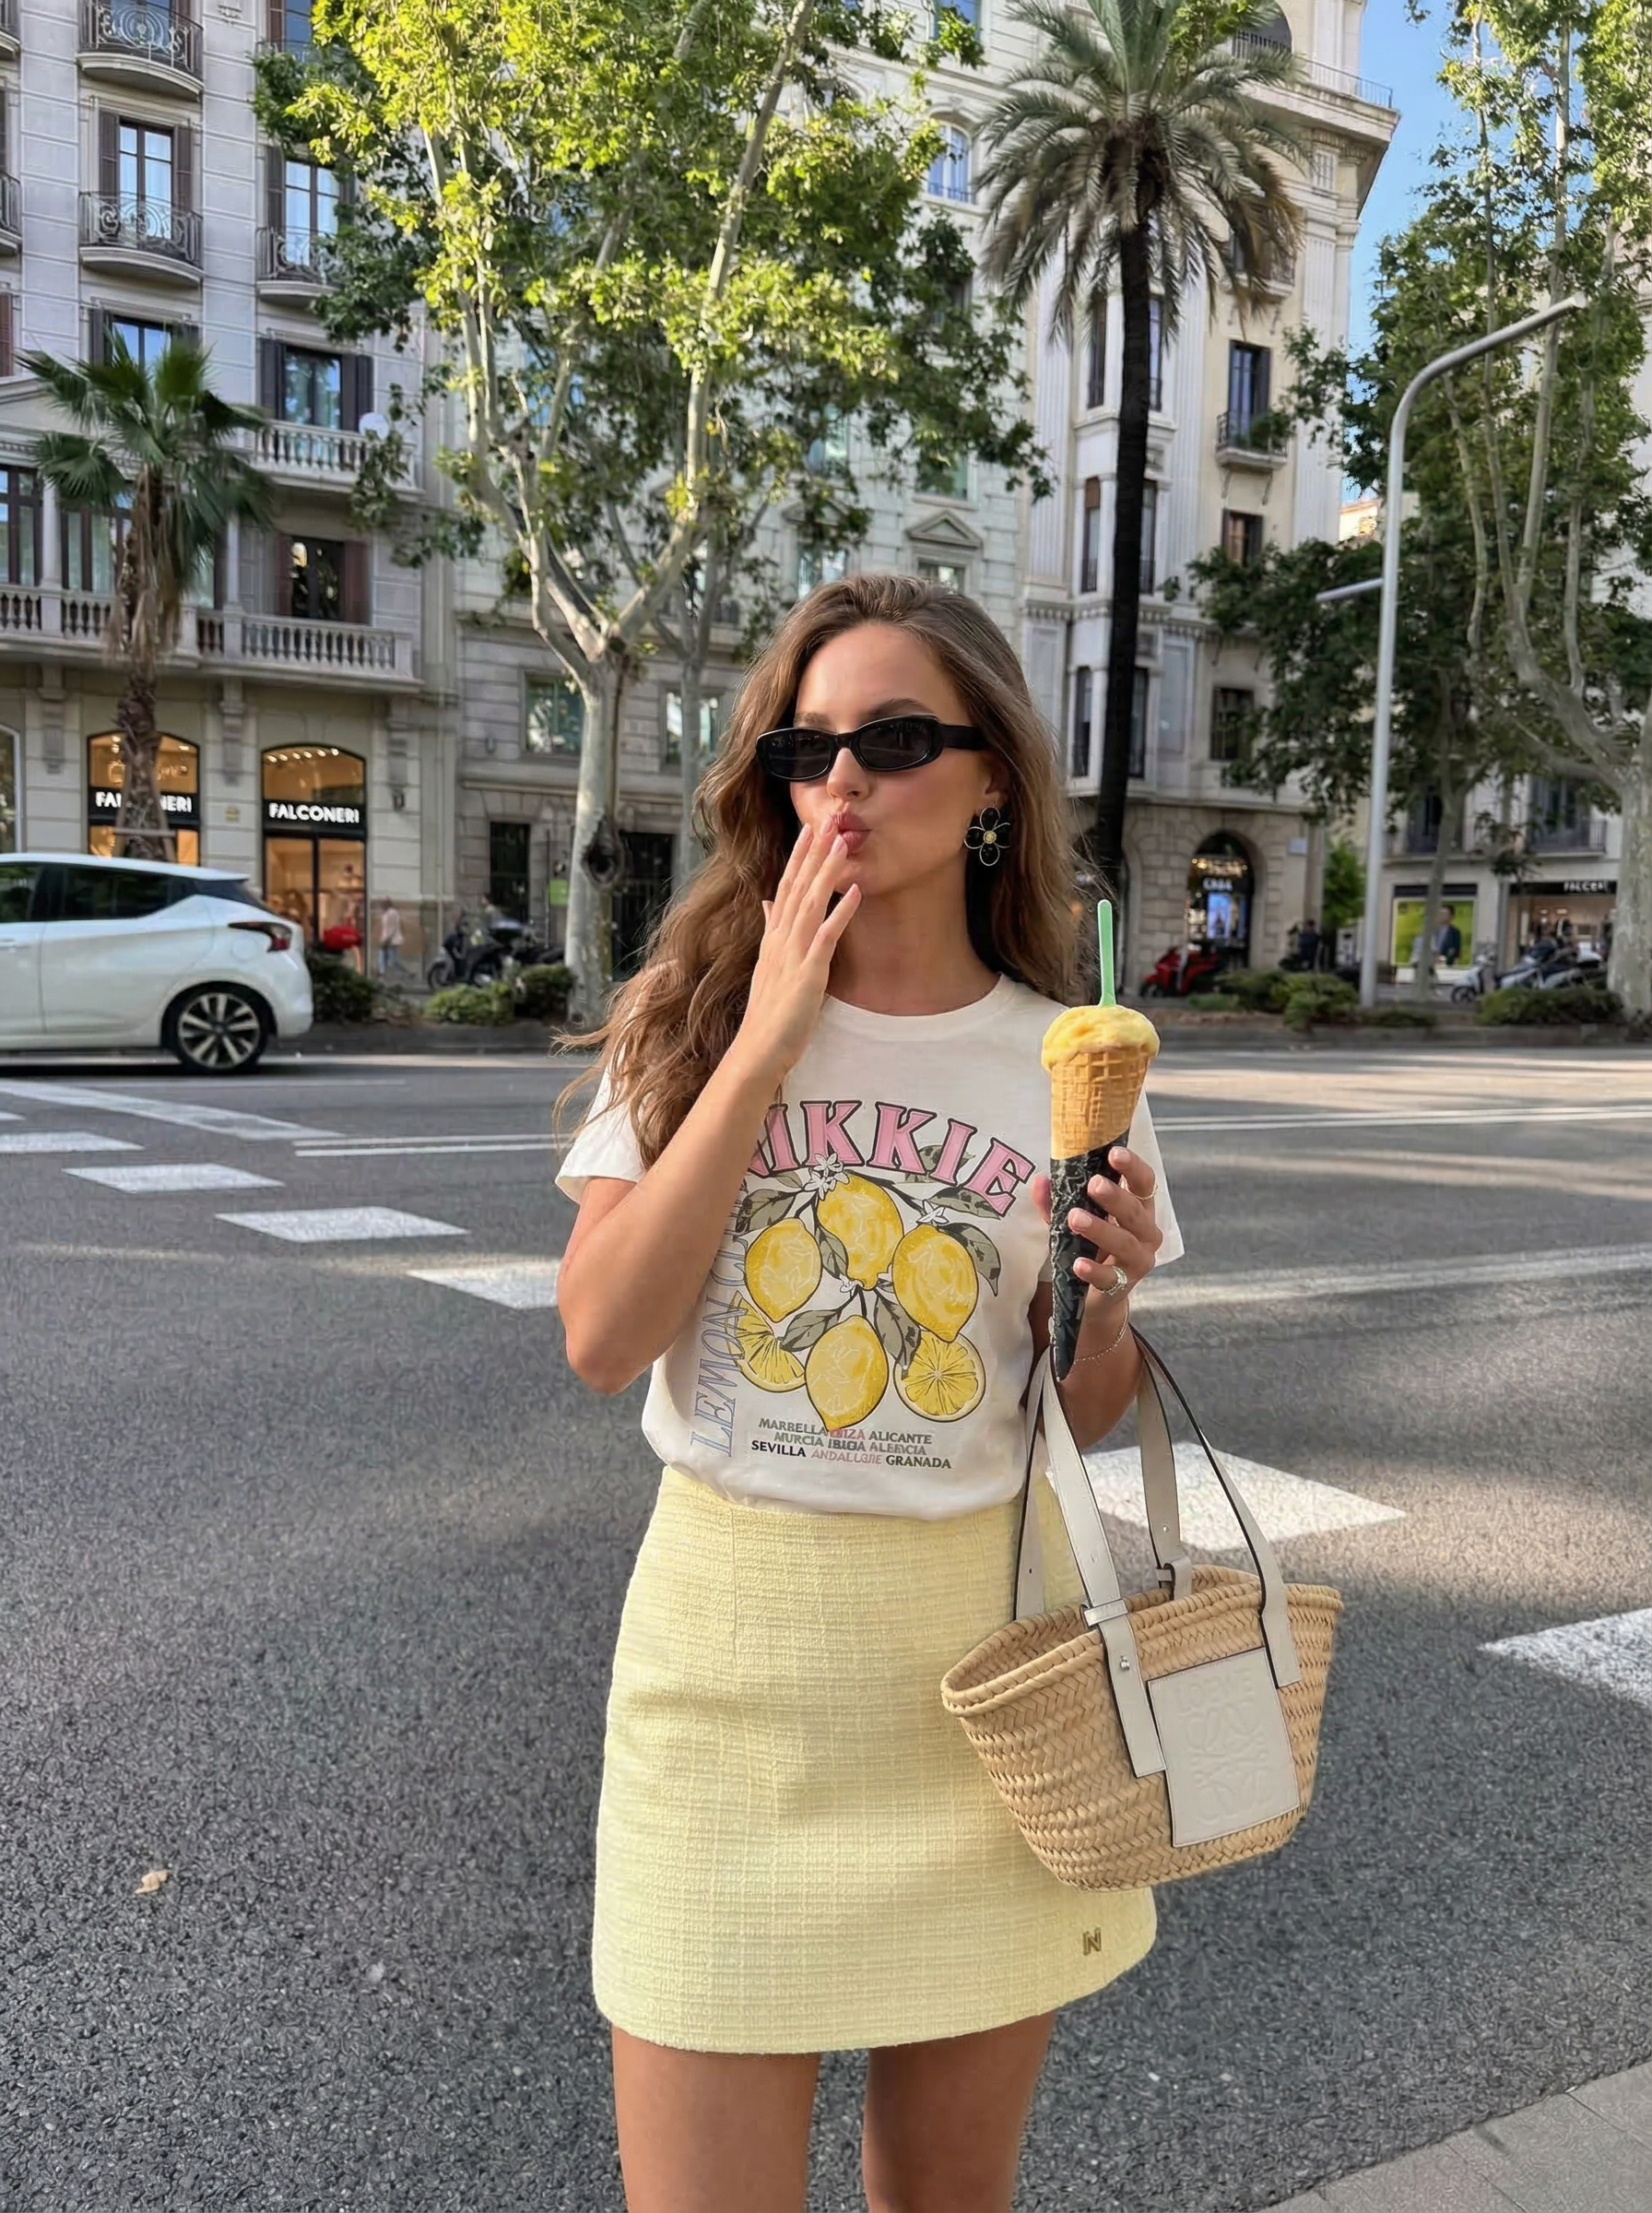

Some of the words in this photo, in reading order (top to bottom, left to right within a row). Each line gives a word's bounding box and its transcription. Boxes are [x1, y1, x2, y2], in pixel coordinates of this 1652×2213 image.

[269, 802, 360, 823] FALCONERI
[690, 1294, 748, 1457] LEMON
[759, 1417, 828, 1437] MARBELLA
[868, 1430, 932, 1445] ALICANTE
[774, 1431, 824, 1447] MURCIA
[751, 1439, 807, 1458] SEVILLA
[886, 1454, 951, 1469] GRANADA
